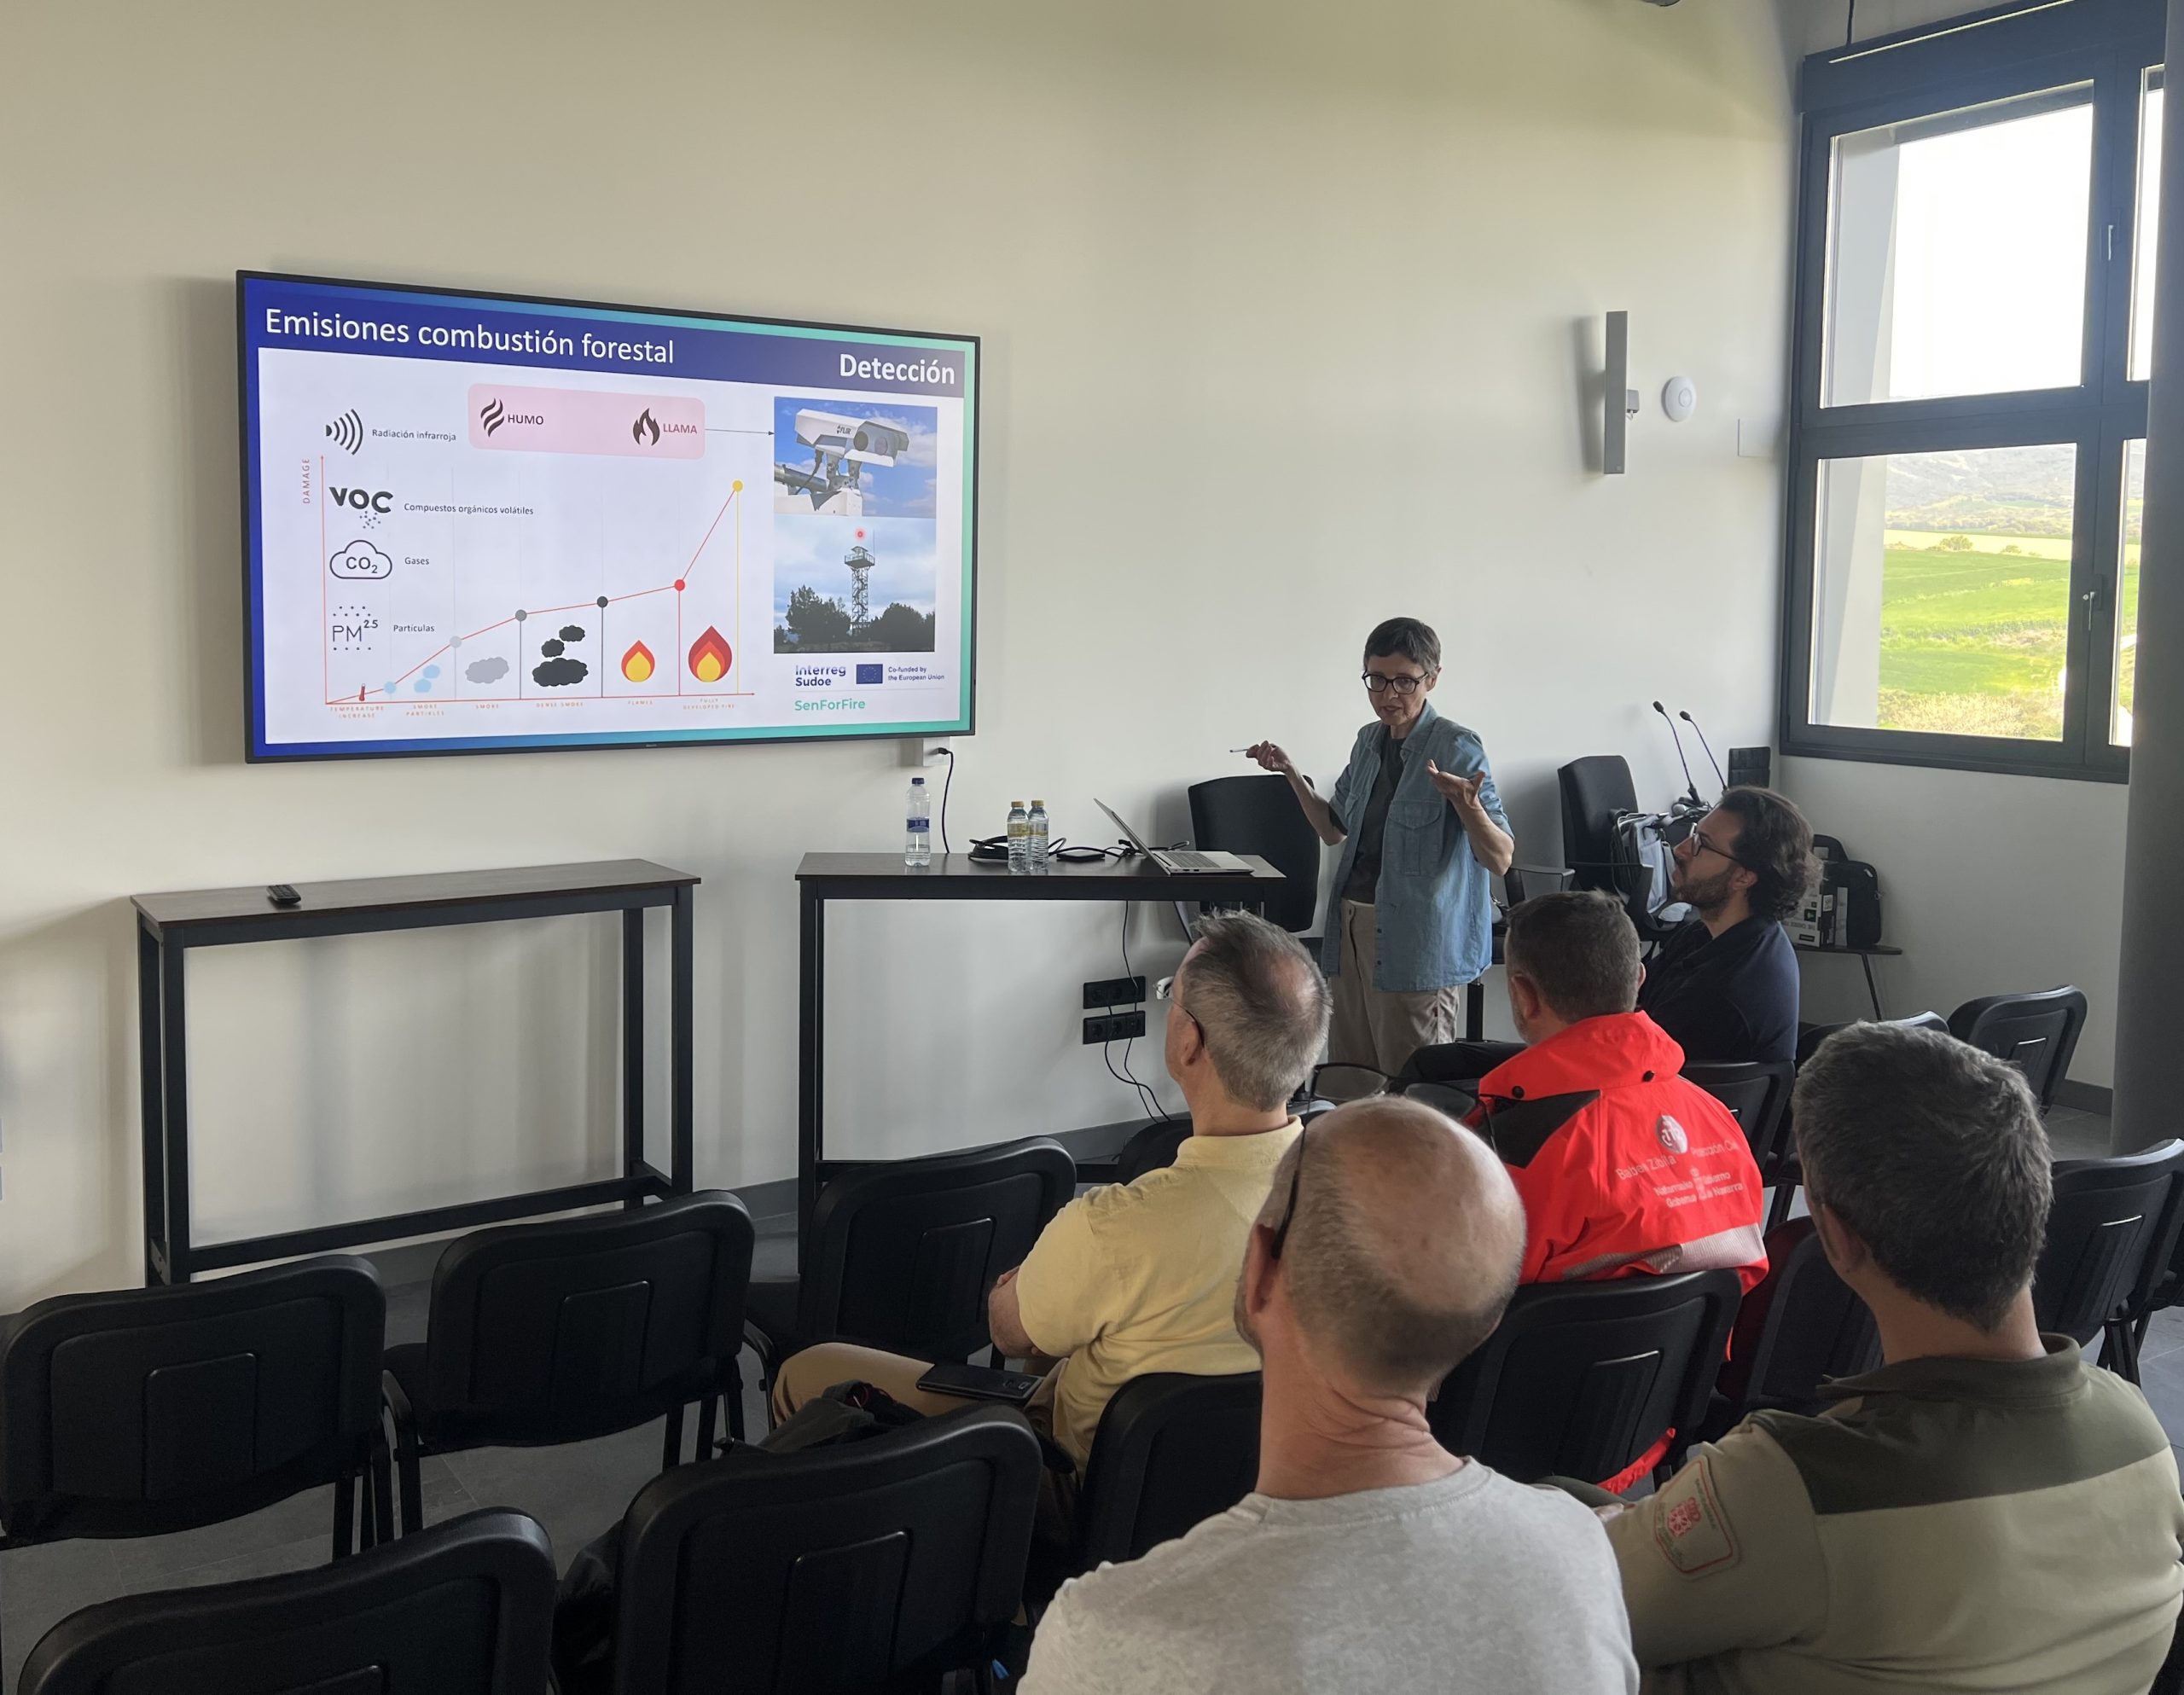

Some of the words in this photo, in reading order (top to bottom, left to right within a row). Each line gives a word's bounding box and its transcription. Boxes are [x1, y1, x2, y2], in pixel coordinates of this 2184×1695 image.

[265, 308, 410, 343] Emisiones
[418, 323, 574, 356] combustión
[581, 334, 674, 363] forestal
[839, 353, 956, 385] Detección
[507, 414, 544, 426] HUMO
[371, 427, 415, 439] Radiación
[416, 429, 456, 442] infrarroja
[662, 422, 698, 435] LLAMA
[328, 485, 394, 514] VOC
[404, 502, 456, 514] Compuestos
[458, 502, 498, 514] orgánicos
[500, 503, 534, 515] volátiles
[404, 556, 430, 566] Gases
[795, 665, 847, 677] Interreg
[921, 666, 927, 675] by
[795, 676, 832, 687] Sudoe
[898, 674, 926, 682] European
[794, 698, 866, 711] SenForFire
